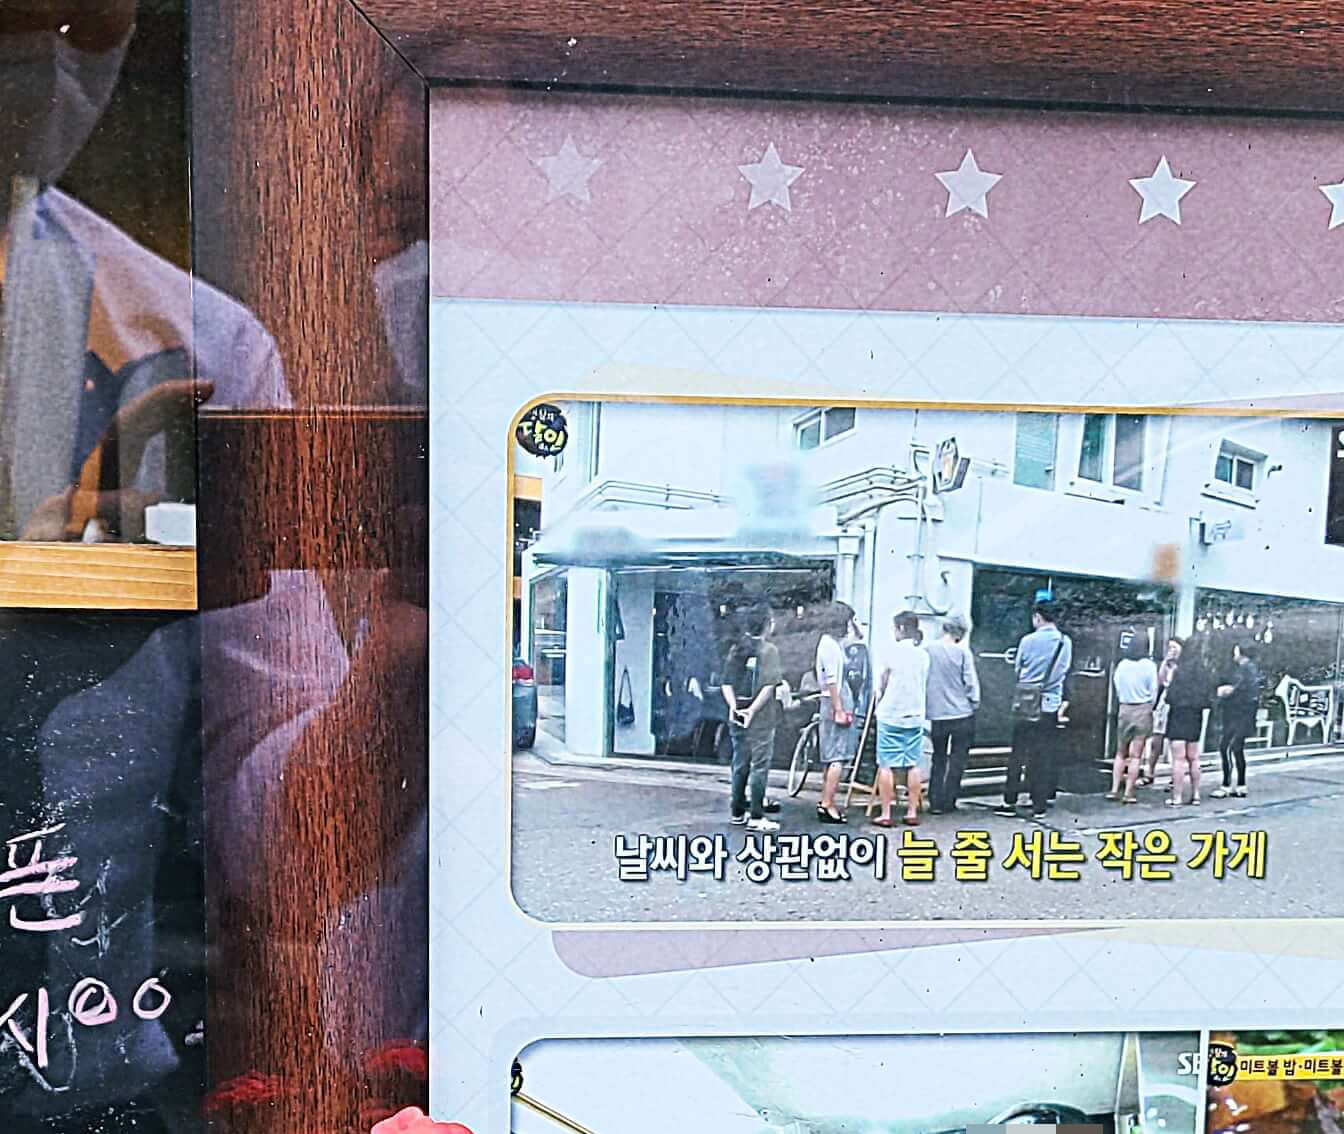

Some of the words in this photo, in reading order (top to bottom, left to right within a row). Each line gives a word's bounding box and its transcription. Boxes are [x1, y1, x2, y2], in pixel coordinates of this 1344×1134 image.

[614, 833, 728, 881] 날씨와
[736, 833, 889, 882] 상관없이
[897, 830, 940, 881] 늘
[951, 830, 993, 881] 줄
[1002, 830, 1086, 881] 서는
[1096, 830, 1178, 881] 작은
[1187, 830, 1268, 880] 가게
[1240, 1059, 1278, 1076] 미트볼
